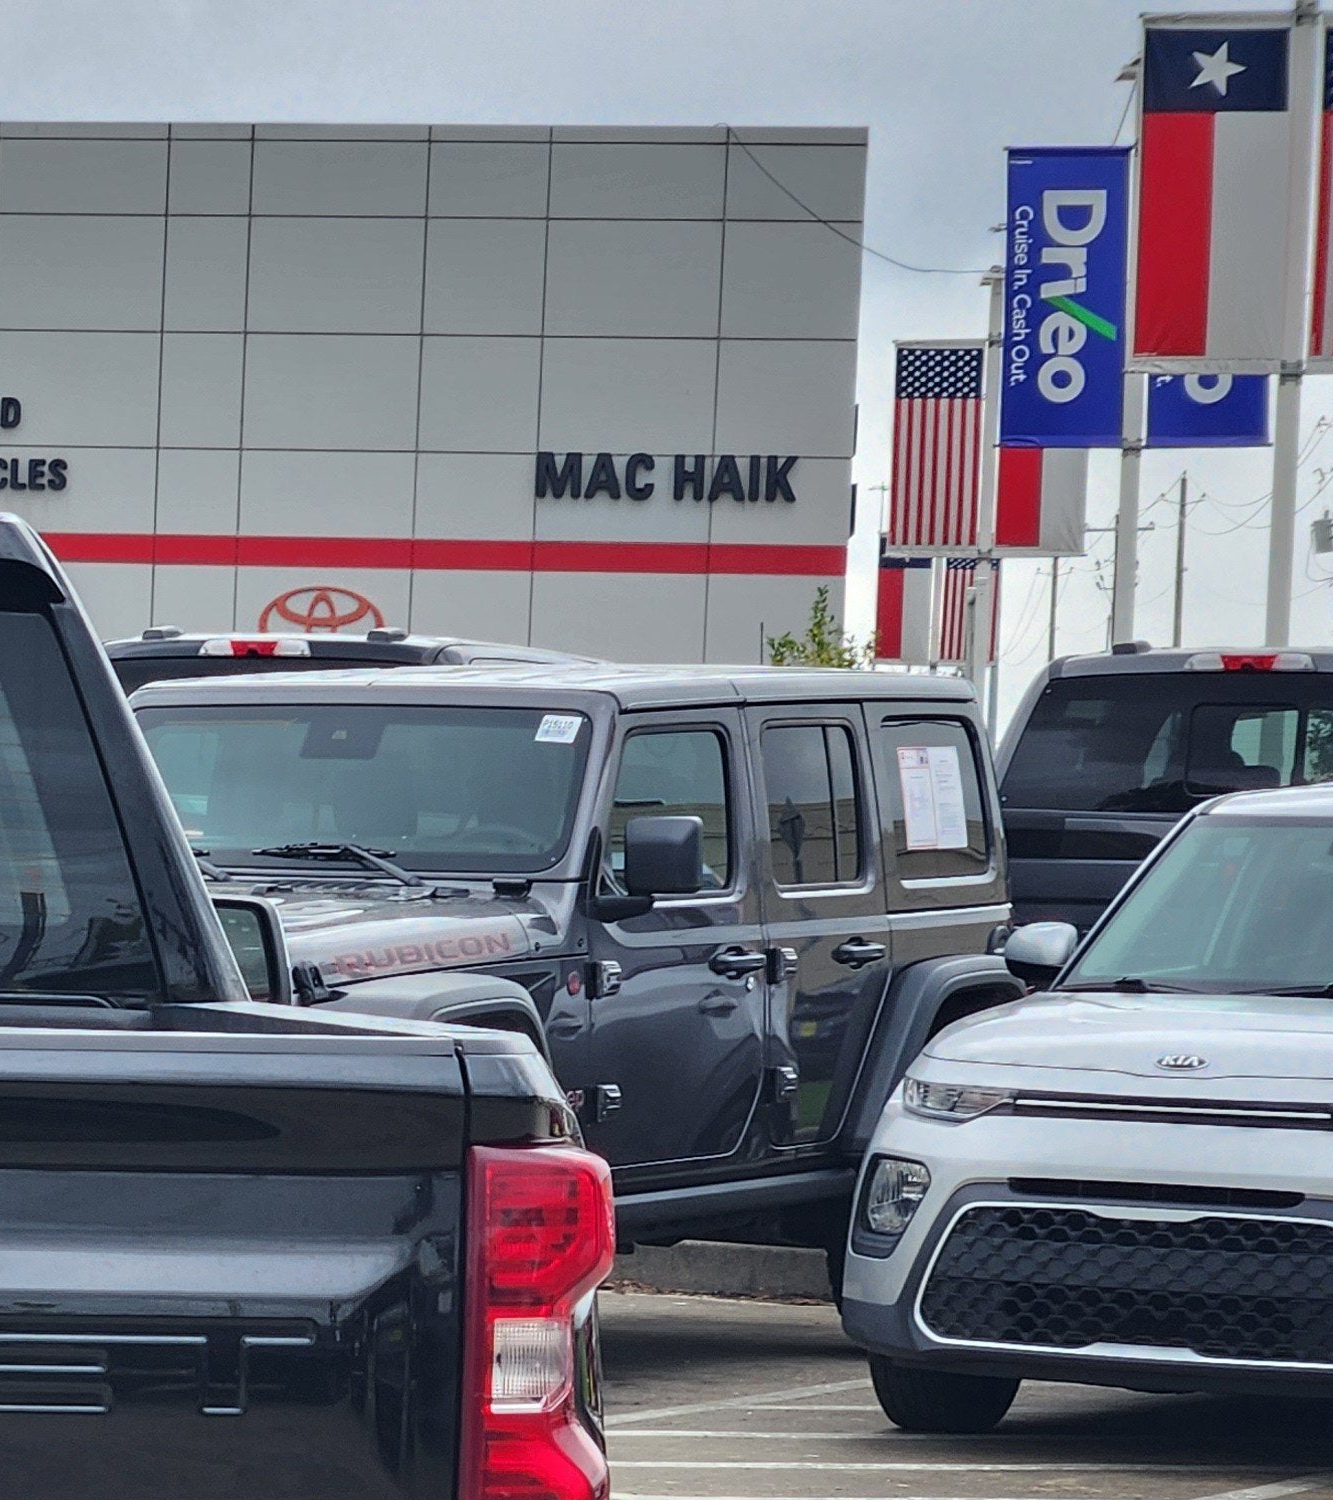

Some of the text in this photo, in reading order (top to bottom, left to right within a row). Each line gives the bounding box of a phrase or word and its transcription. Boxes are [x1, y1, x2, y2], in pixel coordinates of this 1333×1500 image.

[1014, 205, 1034, 266] Cruise
[1011, 293, 1032, 341] Cash
[1009, 344, 1030, 387] Out.
[535, 451, 800, 504] MAC HAIK
[333, 932, 511, 978] RUBICON
[1161, 1055, 1199, 1067] KIA
